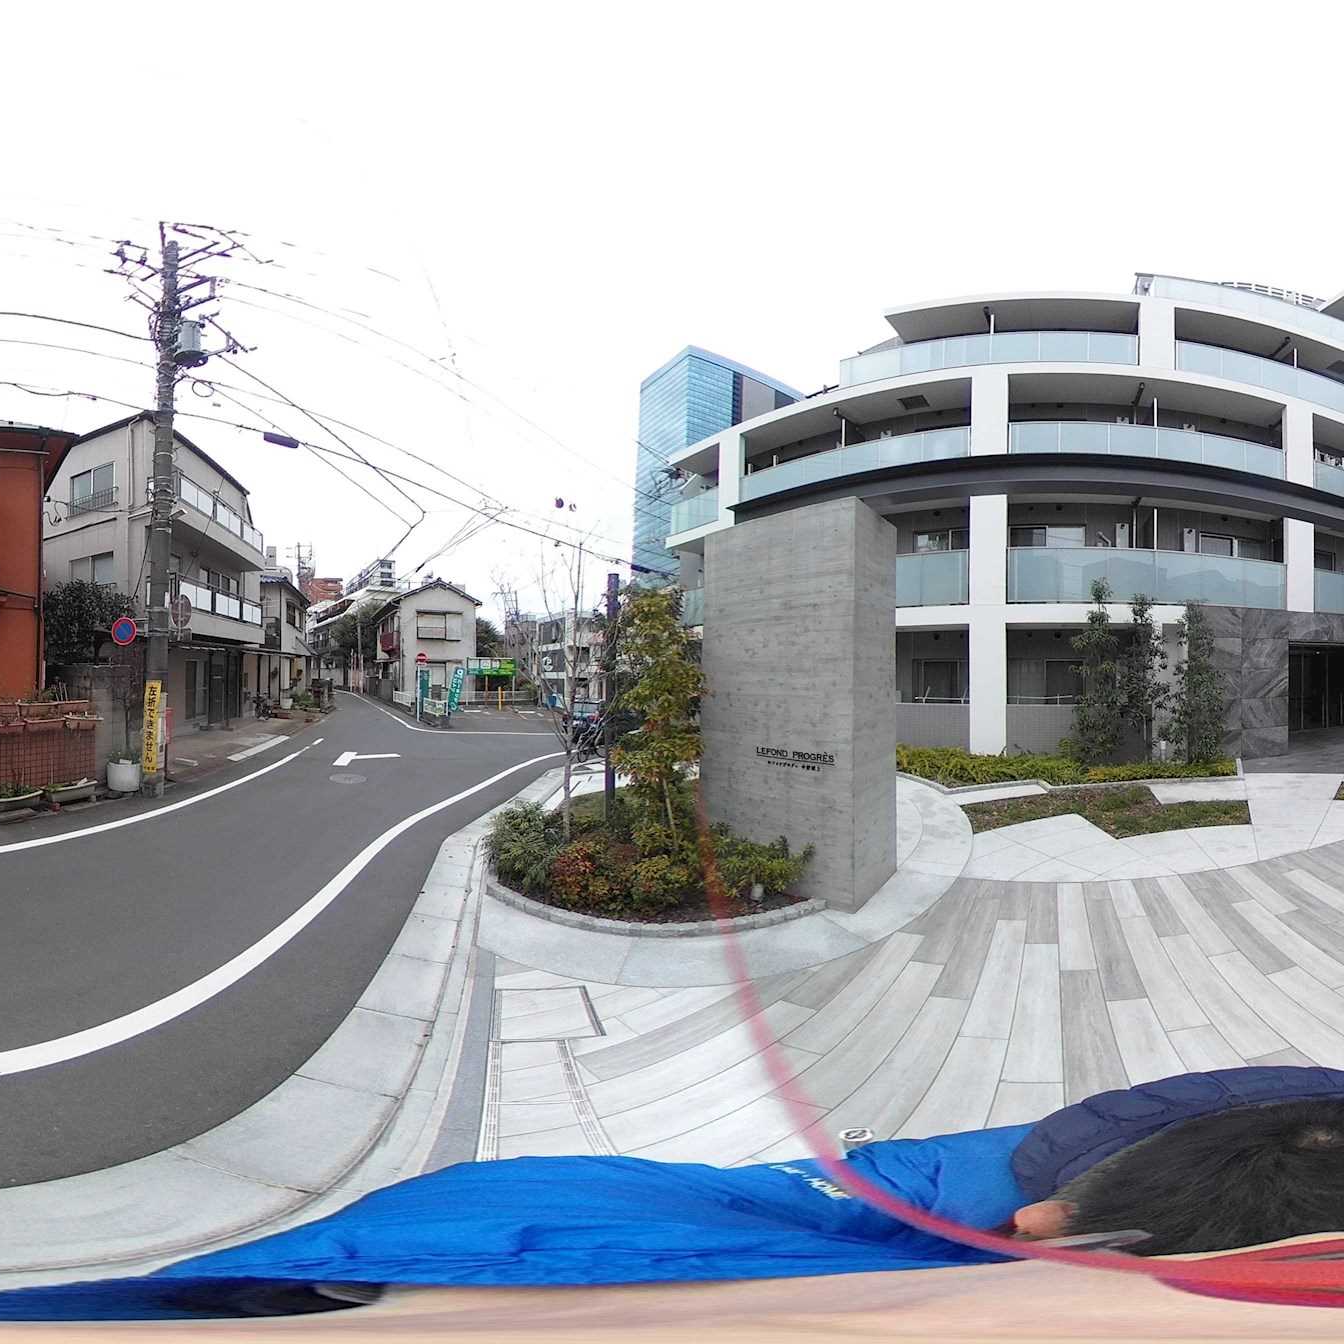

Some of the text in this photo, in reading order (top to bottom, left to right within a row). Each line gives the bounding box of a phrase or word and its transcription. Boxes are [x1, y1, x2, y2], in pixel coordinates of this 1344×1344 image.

[146, 685, 157, 763] 左折できません
[756, 746, 835, 763] LEFOND PROGRÈS
